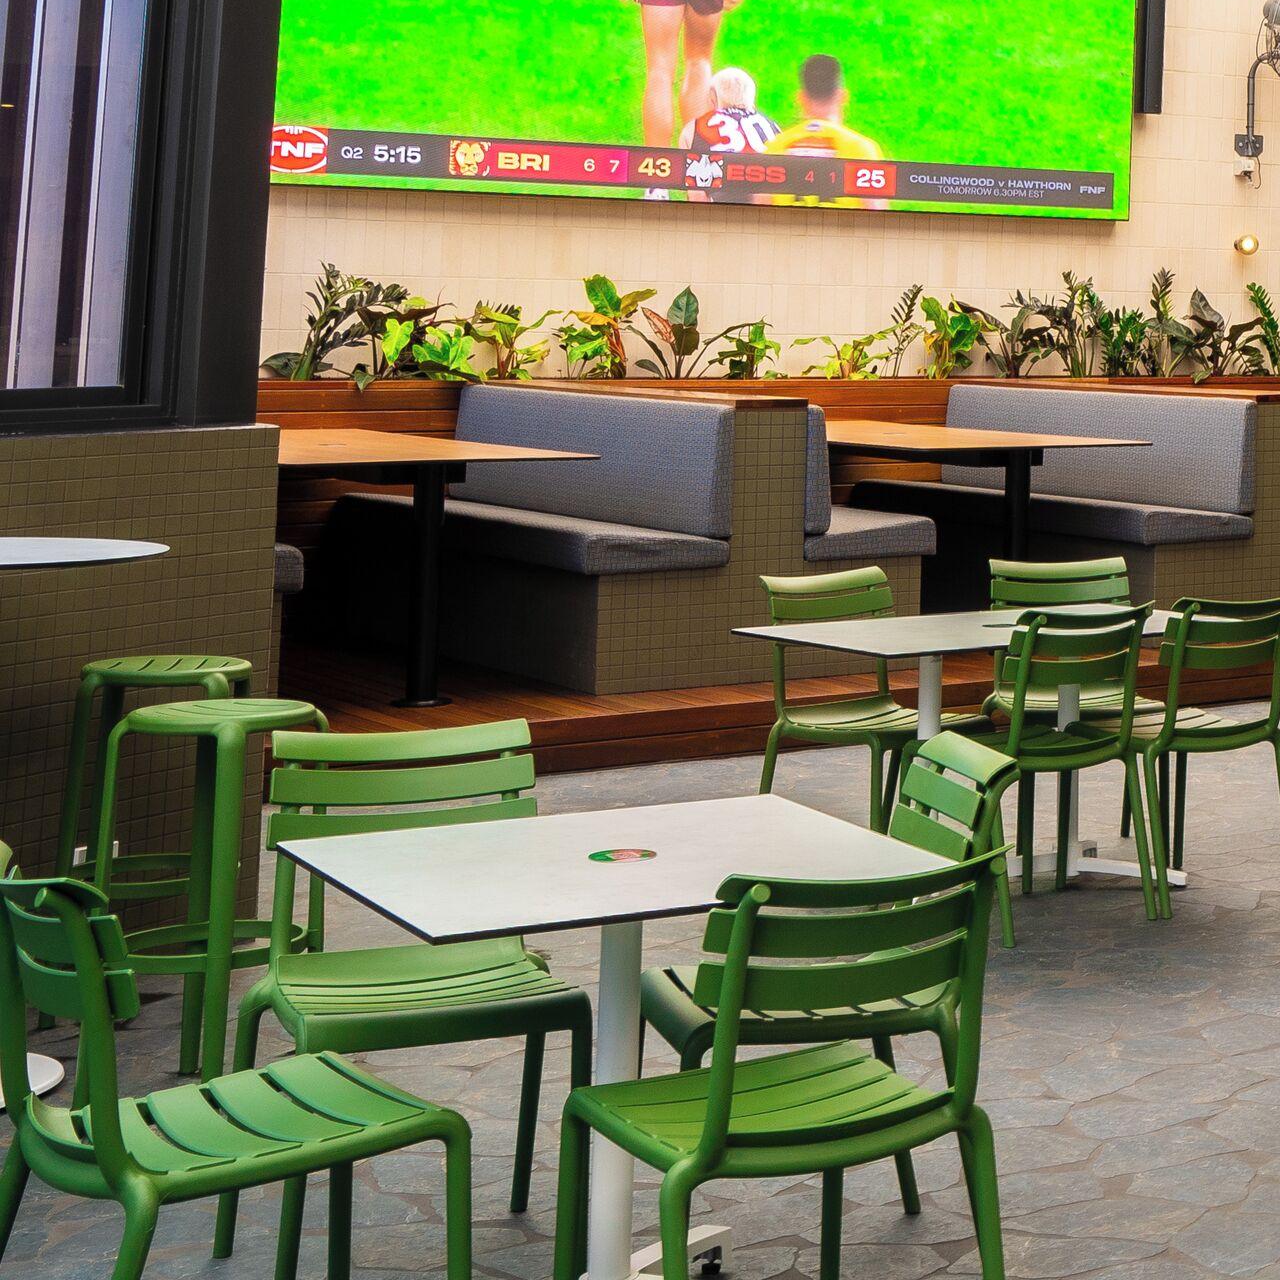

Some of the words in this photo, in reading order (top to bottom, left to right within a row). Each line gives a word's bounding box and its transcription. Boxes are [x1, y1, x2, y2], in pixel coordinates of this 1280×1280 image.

[707, 111, 770, 154] 30
[341, 146, 363, 159] Q2
[373, 144, 421, 164] 5:15
[497, 152, 550, 172] BRI
[583, 159, 595, 173] 6
[608, 160, 620, 174] 7
[637, 157, 672, 177] 43
[726, 164, 786, 184] ESS
[804, 171, 815, 184] 4
[830, 173, 836, 184] 1
[856, 169, 886, 188] 25
[909, 174, 995, 187] COLLINGWOOD
[1007, 179, 1072, 191] HAWTHORN
[938, 185, 992, 196] TOMORROW
[1028, 190, 1045, 199] EST
[1079, 185, 1106, 195] FNF
